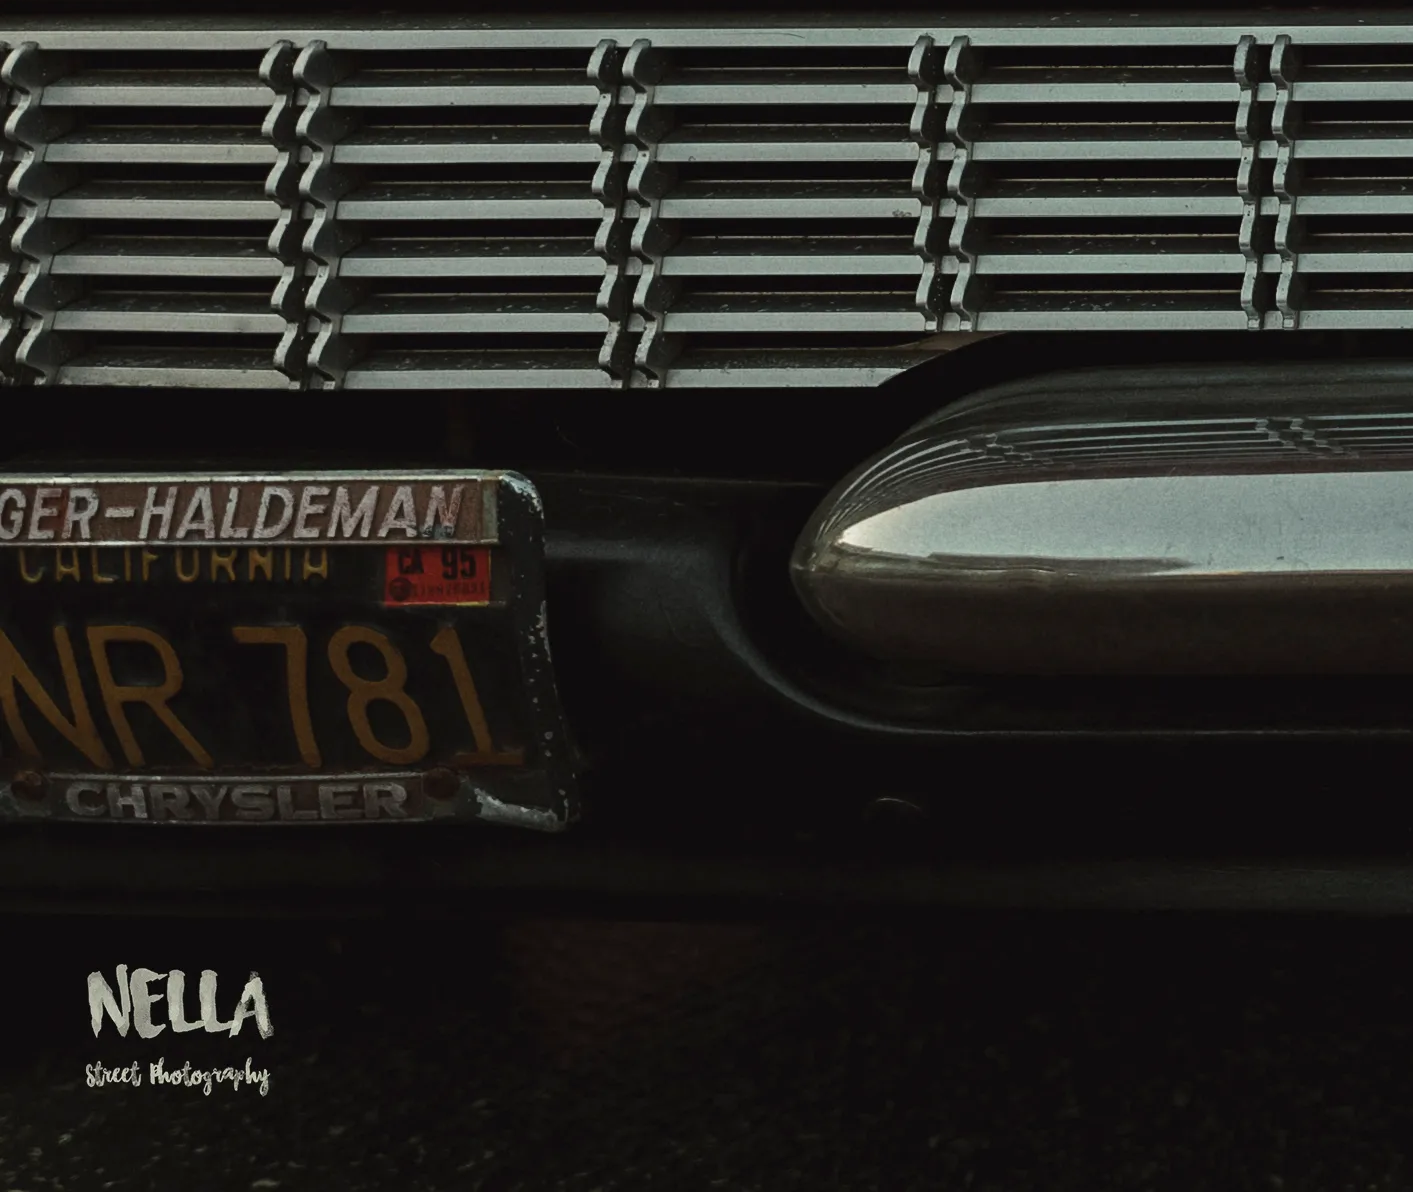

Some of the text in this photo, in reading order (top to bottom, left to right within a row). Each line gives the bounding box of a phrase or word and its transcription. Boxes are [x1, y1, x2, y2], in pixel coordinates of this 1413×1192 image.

[18, 548, 329, 584] CALIFORNIA
[442, 546, 477, 580] 95
[232, 625, 524, 769] 781
[66, 781, 409, 820] CHRYSLER
